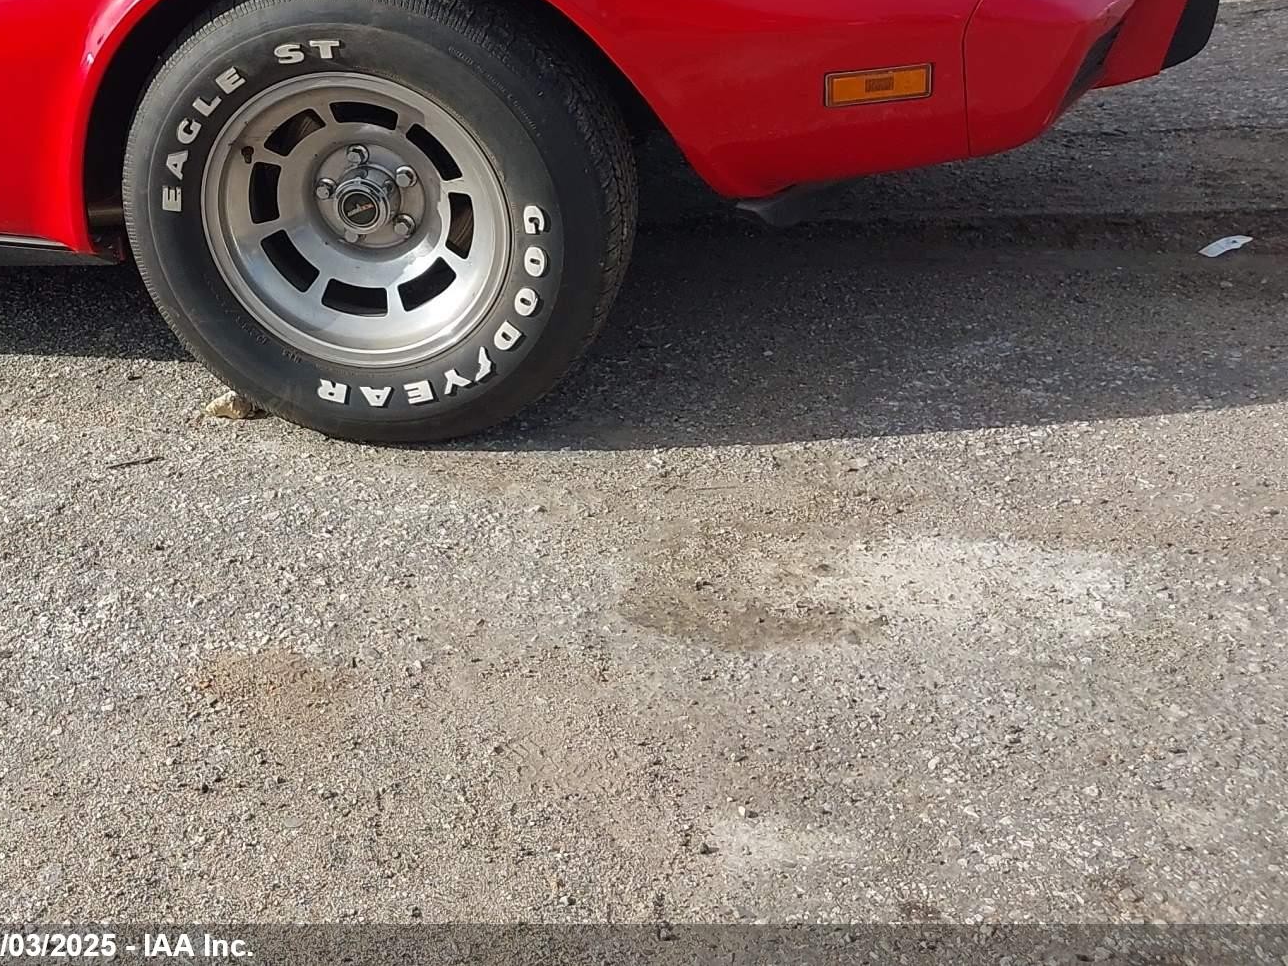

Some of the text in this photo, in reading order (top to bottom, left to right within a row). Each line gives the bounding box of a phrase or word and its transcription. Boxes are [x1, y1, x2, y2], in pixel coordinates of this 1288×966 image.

[162, 40, 341, 212] EAGLE ST
[317, 205, 545, 407] GOODYEAR
